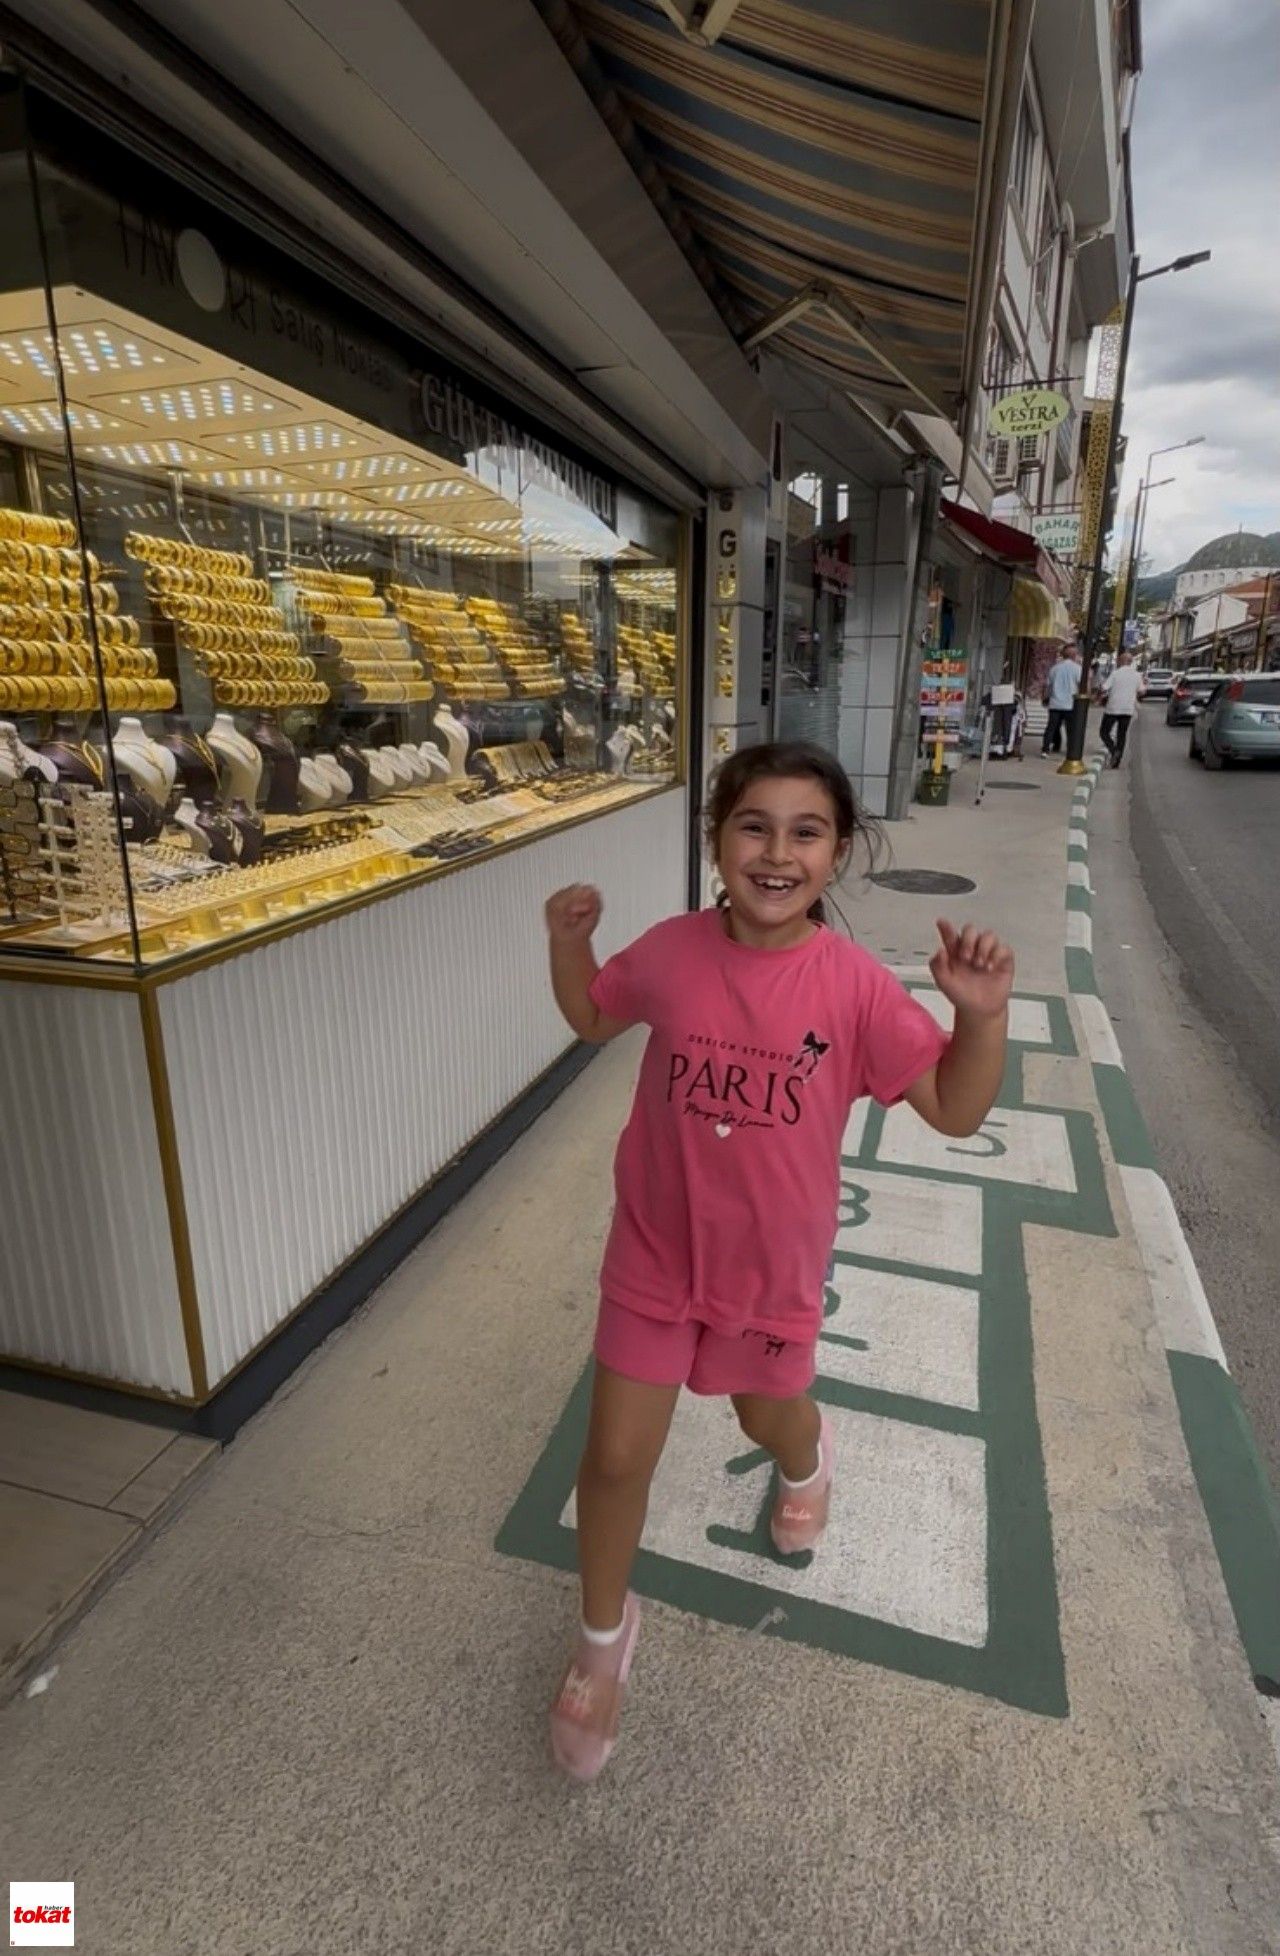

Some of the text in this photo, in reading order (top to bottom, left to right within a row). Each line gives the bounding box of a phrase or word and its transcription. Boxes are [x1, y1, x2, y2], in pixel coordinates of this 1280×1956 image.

[999, 405, 1059, 424] VESTRA
[688, 1033, 794, 1063] DESIGN STUDIO
[667, 1053, 804, 1126] PARIS
